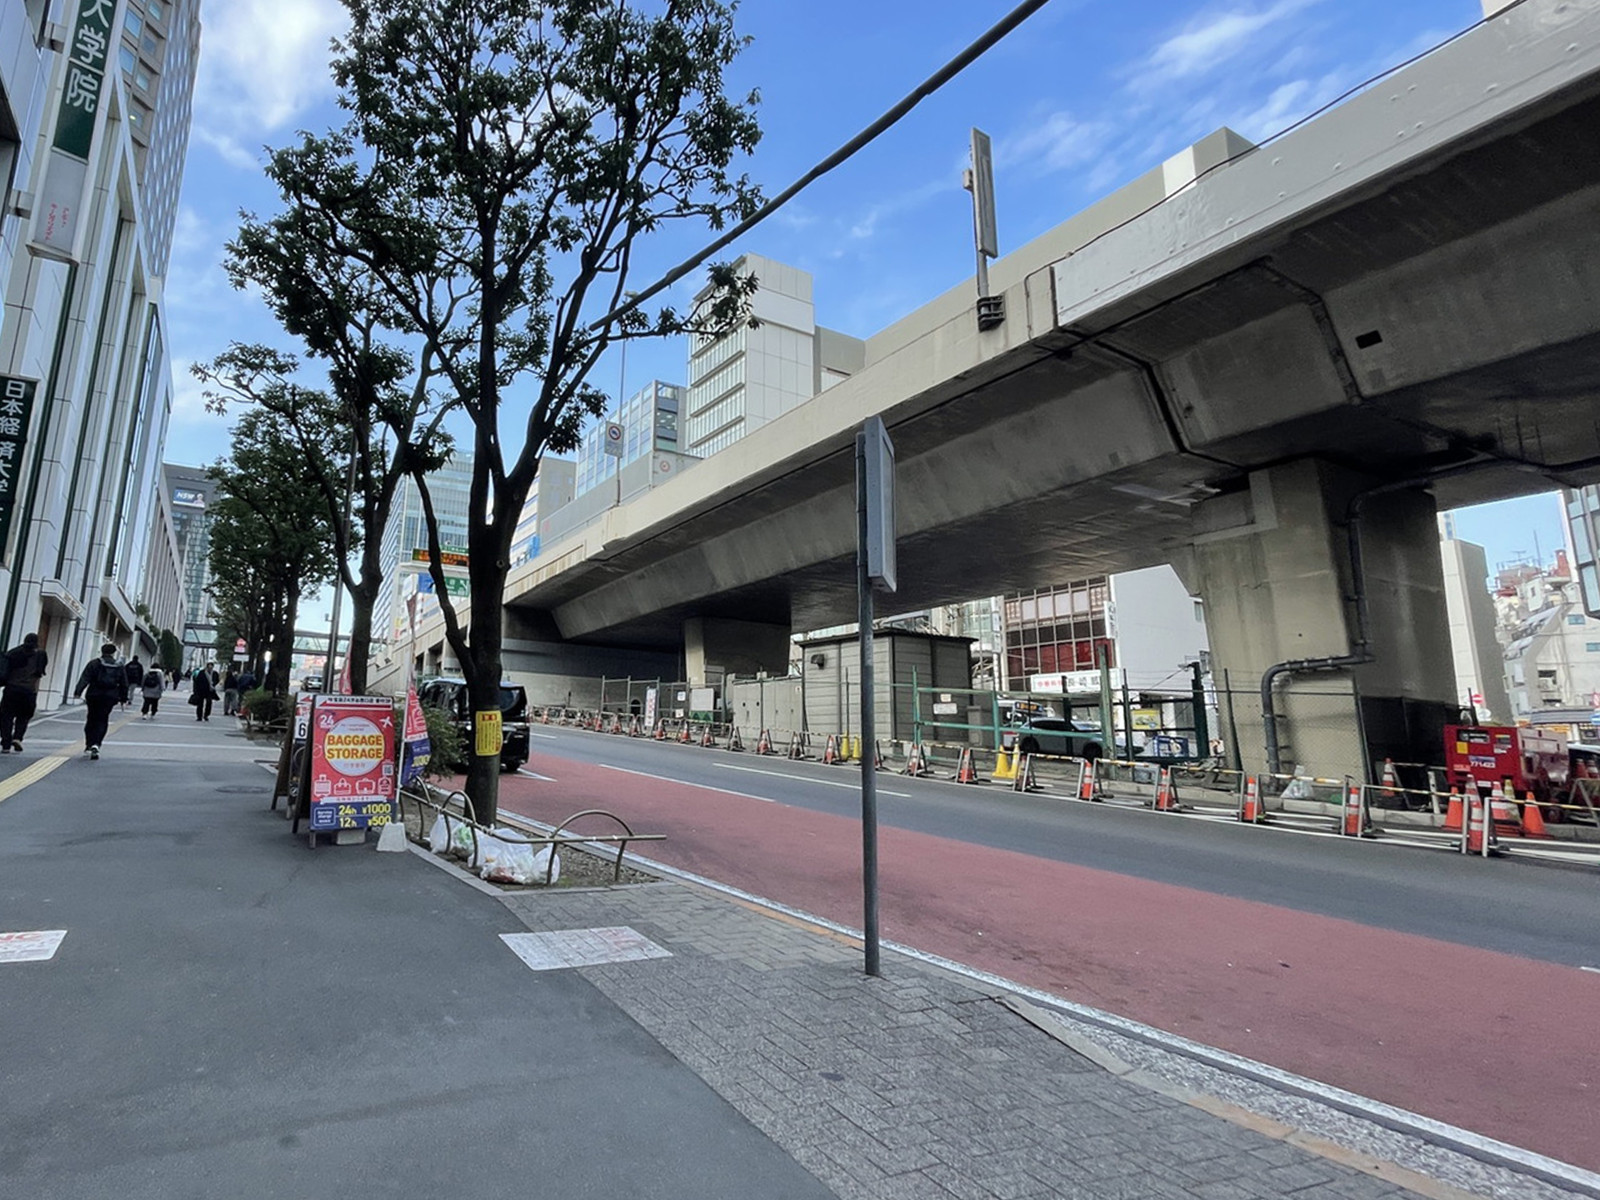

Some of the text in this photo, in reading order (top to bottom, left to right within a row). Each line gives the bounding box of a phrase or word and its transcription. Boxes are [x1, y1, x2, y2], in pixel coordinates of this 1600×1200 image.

[66, 0, 113, 113] 大学院
[298, 722, 306, 737] 6
[327, 734, 383, 746] BAGGAGE
[327, 747, 383, 759] STORAGE
